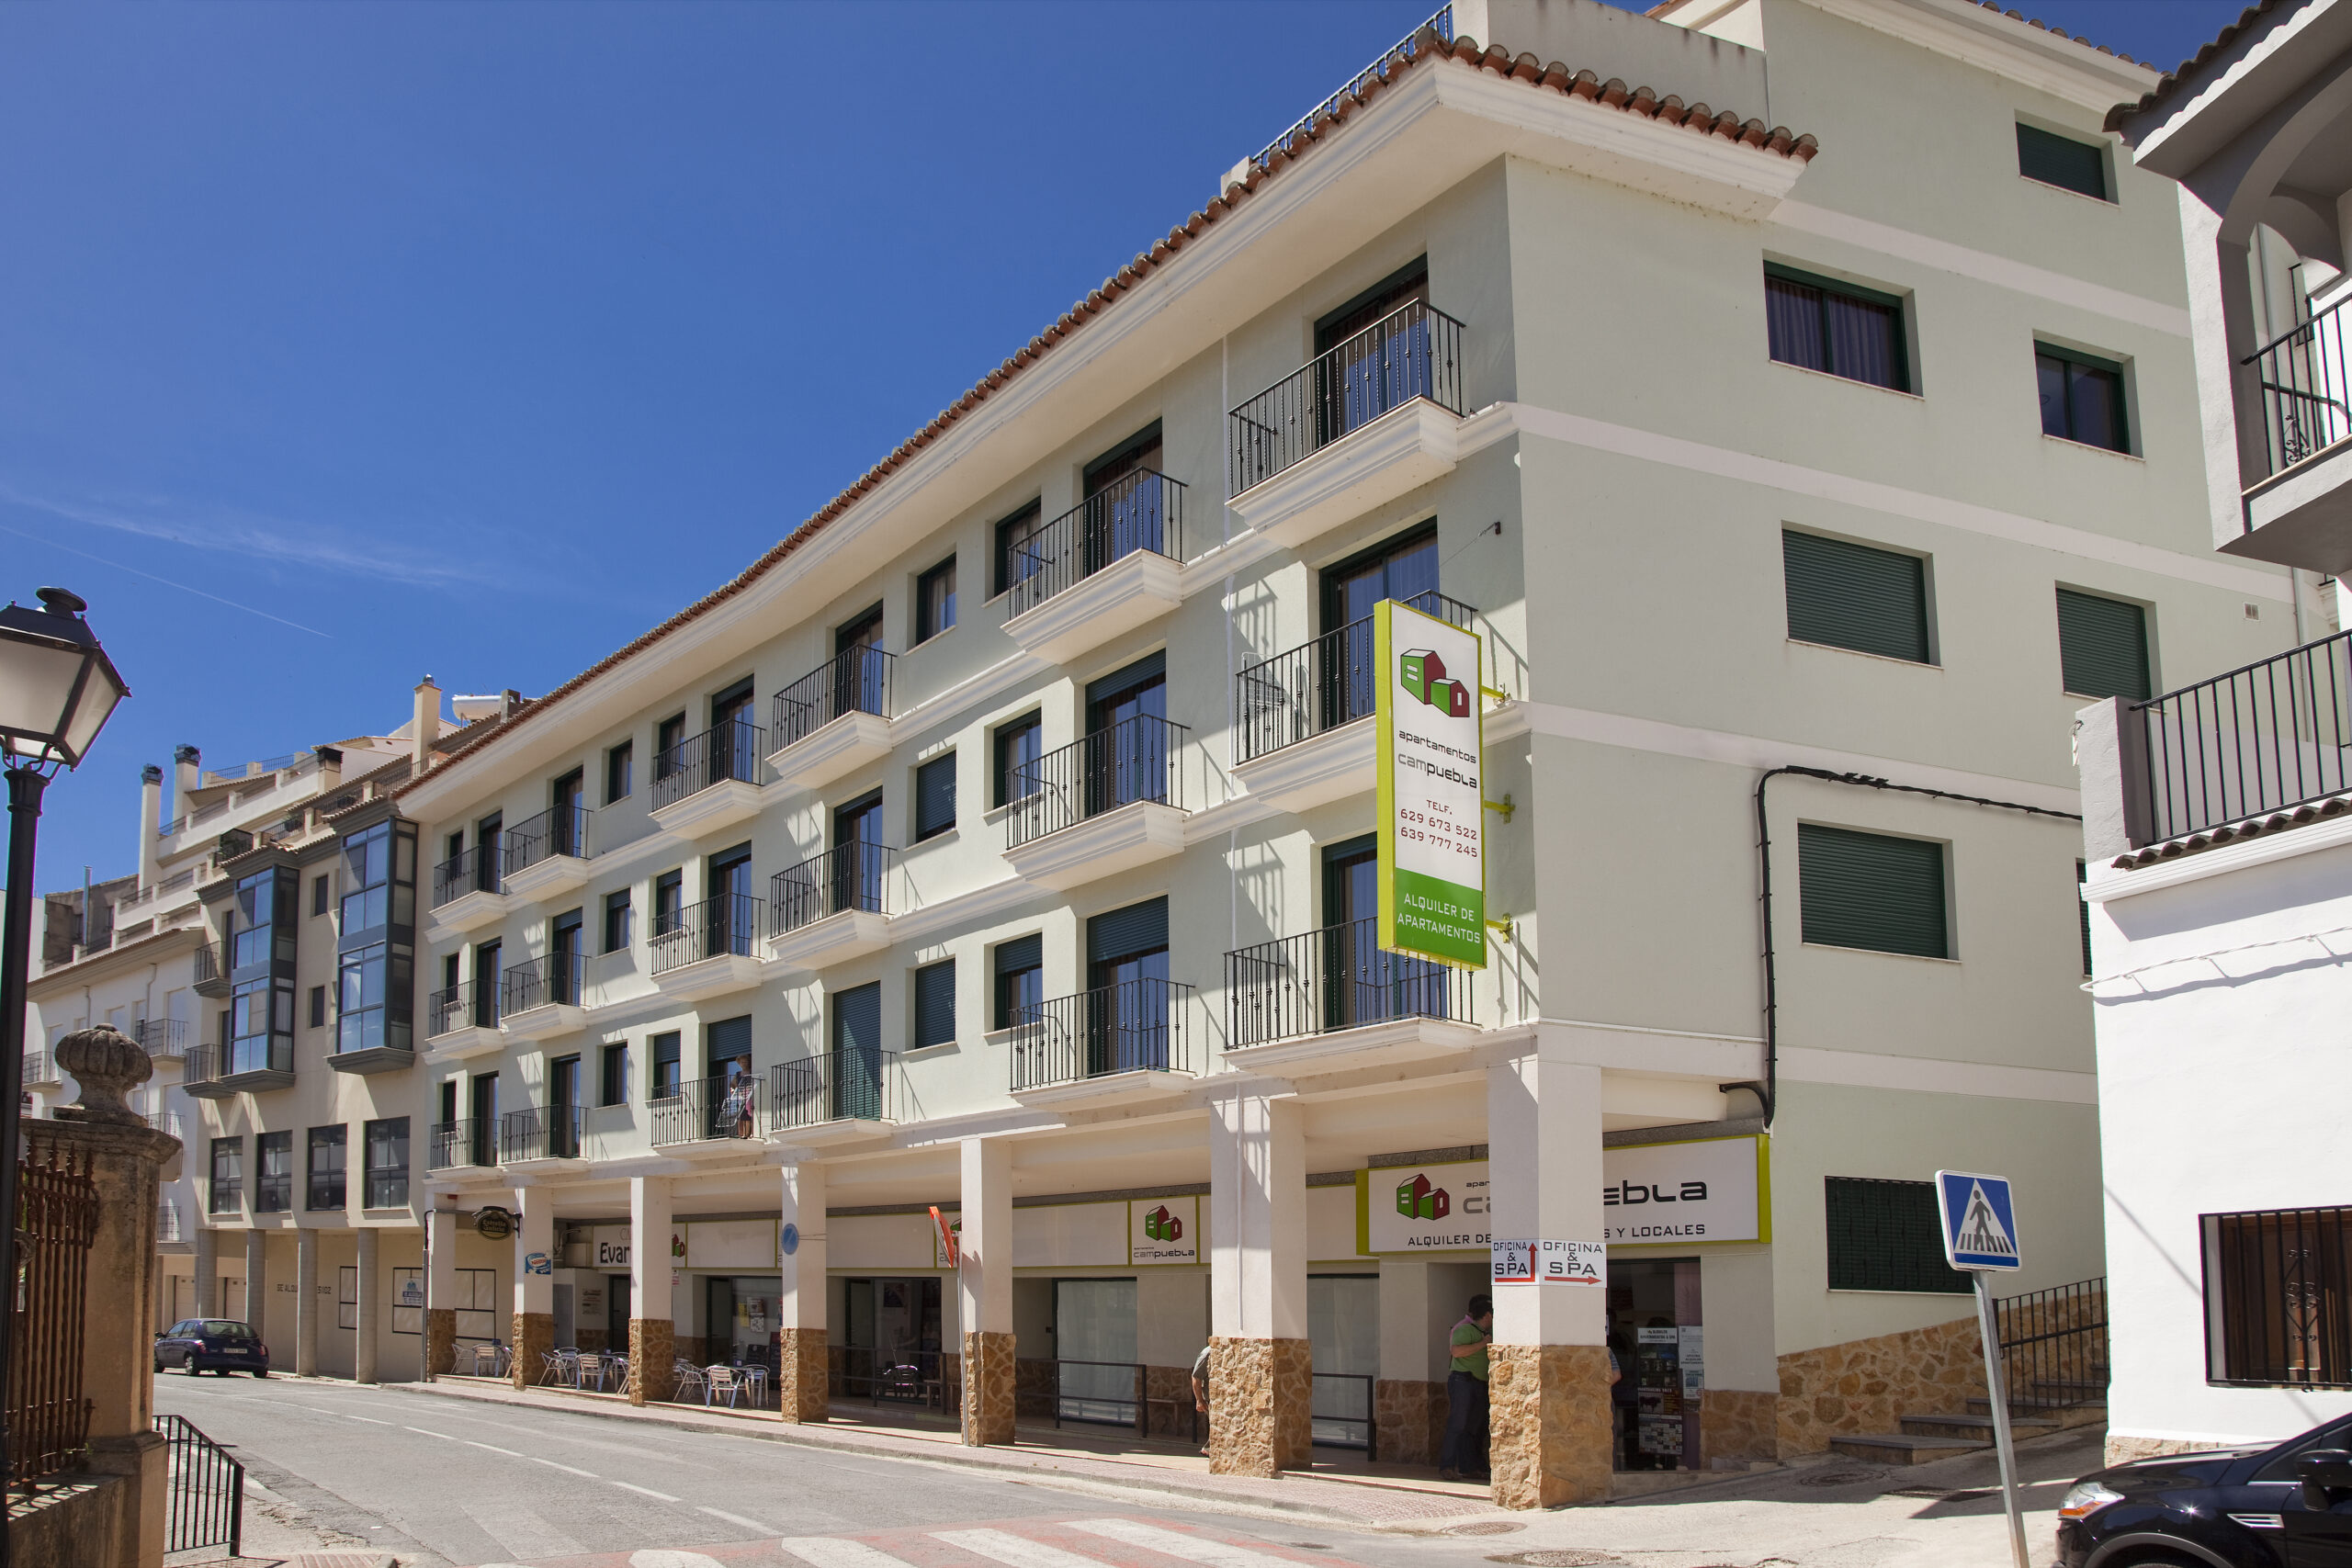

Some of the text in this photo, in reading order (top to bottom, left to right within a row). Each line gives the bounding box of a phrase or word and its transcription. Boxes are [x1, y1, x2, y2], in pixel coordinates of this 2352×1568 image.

[1398, 730, 1476, 763] apartamentos
[1397, 753, 1477, 788] campuebla
[1426, 799, 1452, 815] TELF.
[1400, 808, 1477, 840] 629 673 522
[1400, 827, 1477, 858] 639 777 245
[1404, 893, 1475, 921] ALQUILER DE
[1397, 912, 1480, 944] APARTAMENTOS
[1408, 1235, 1470, 1247] ALQUILER
[1476, 1234, 1492, 1244] DE
[1617, 1227, 1625, 1237] Y
[1632, 1224, 1705, 1237] LOCALES
[1133, 1248, 1195, 1259] campuebla
[1493, 1242, 1527, 1251] OFICINA
[1544, 1241, 1602, 1254] OFICINA
[1508, 1252, 1516, 1261] &
[1567, 1252, 1577, 1261] &
[1495, 1262, 1528, 1275] SPA
[1549, 1262, 1597, 1276] SPA
